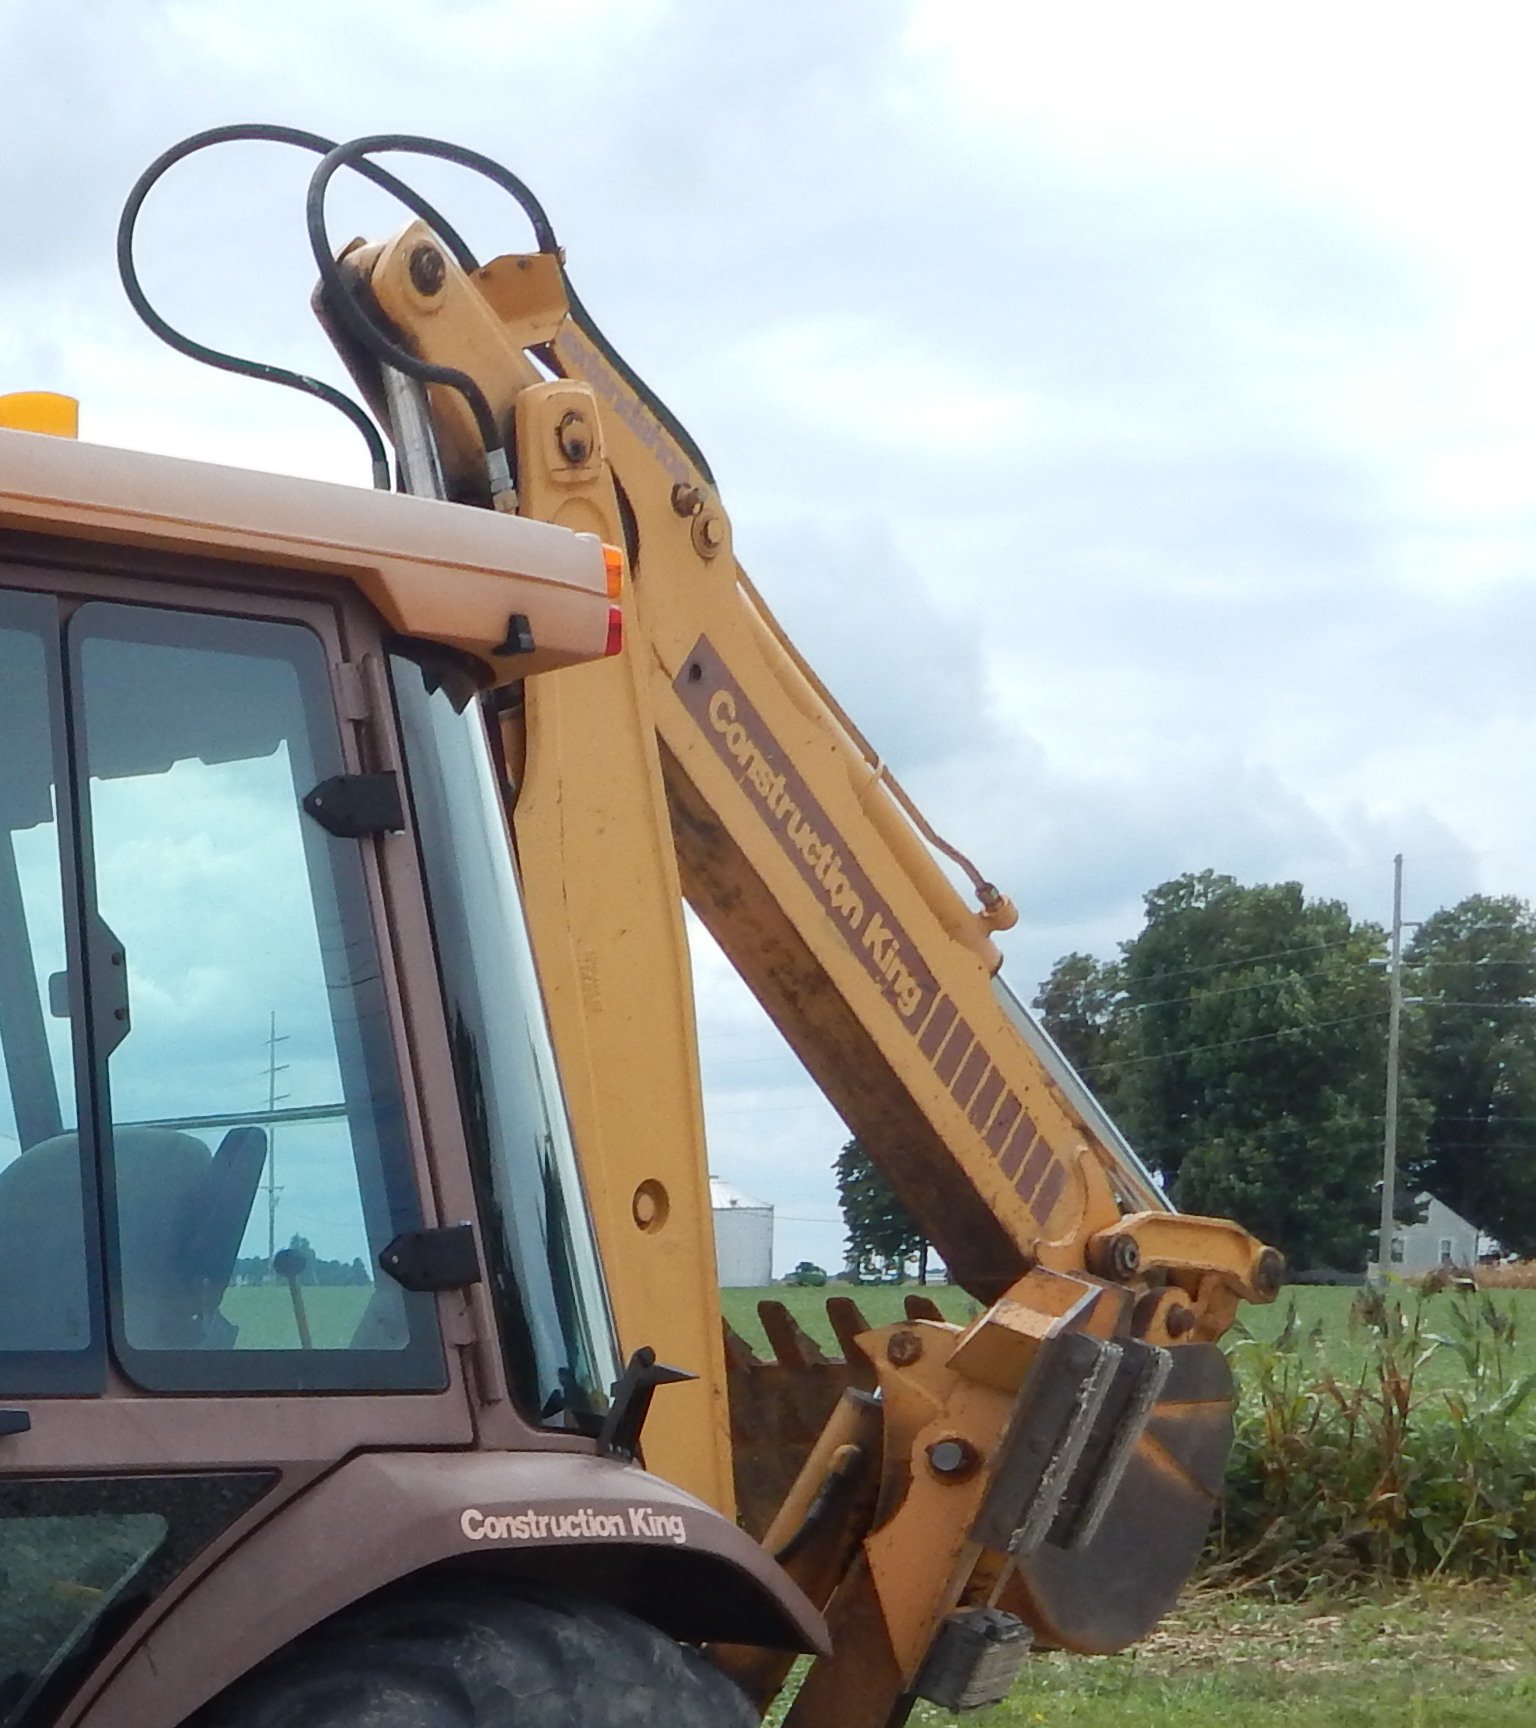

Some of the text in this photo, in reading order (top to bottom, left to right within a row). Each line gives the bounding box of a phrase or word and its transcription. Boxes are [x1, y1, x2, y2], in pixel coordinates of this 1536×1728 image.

[708, 689, 923, 1017] Construction King
[460, 1507, 686, 1543] Construction King
